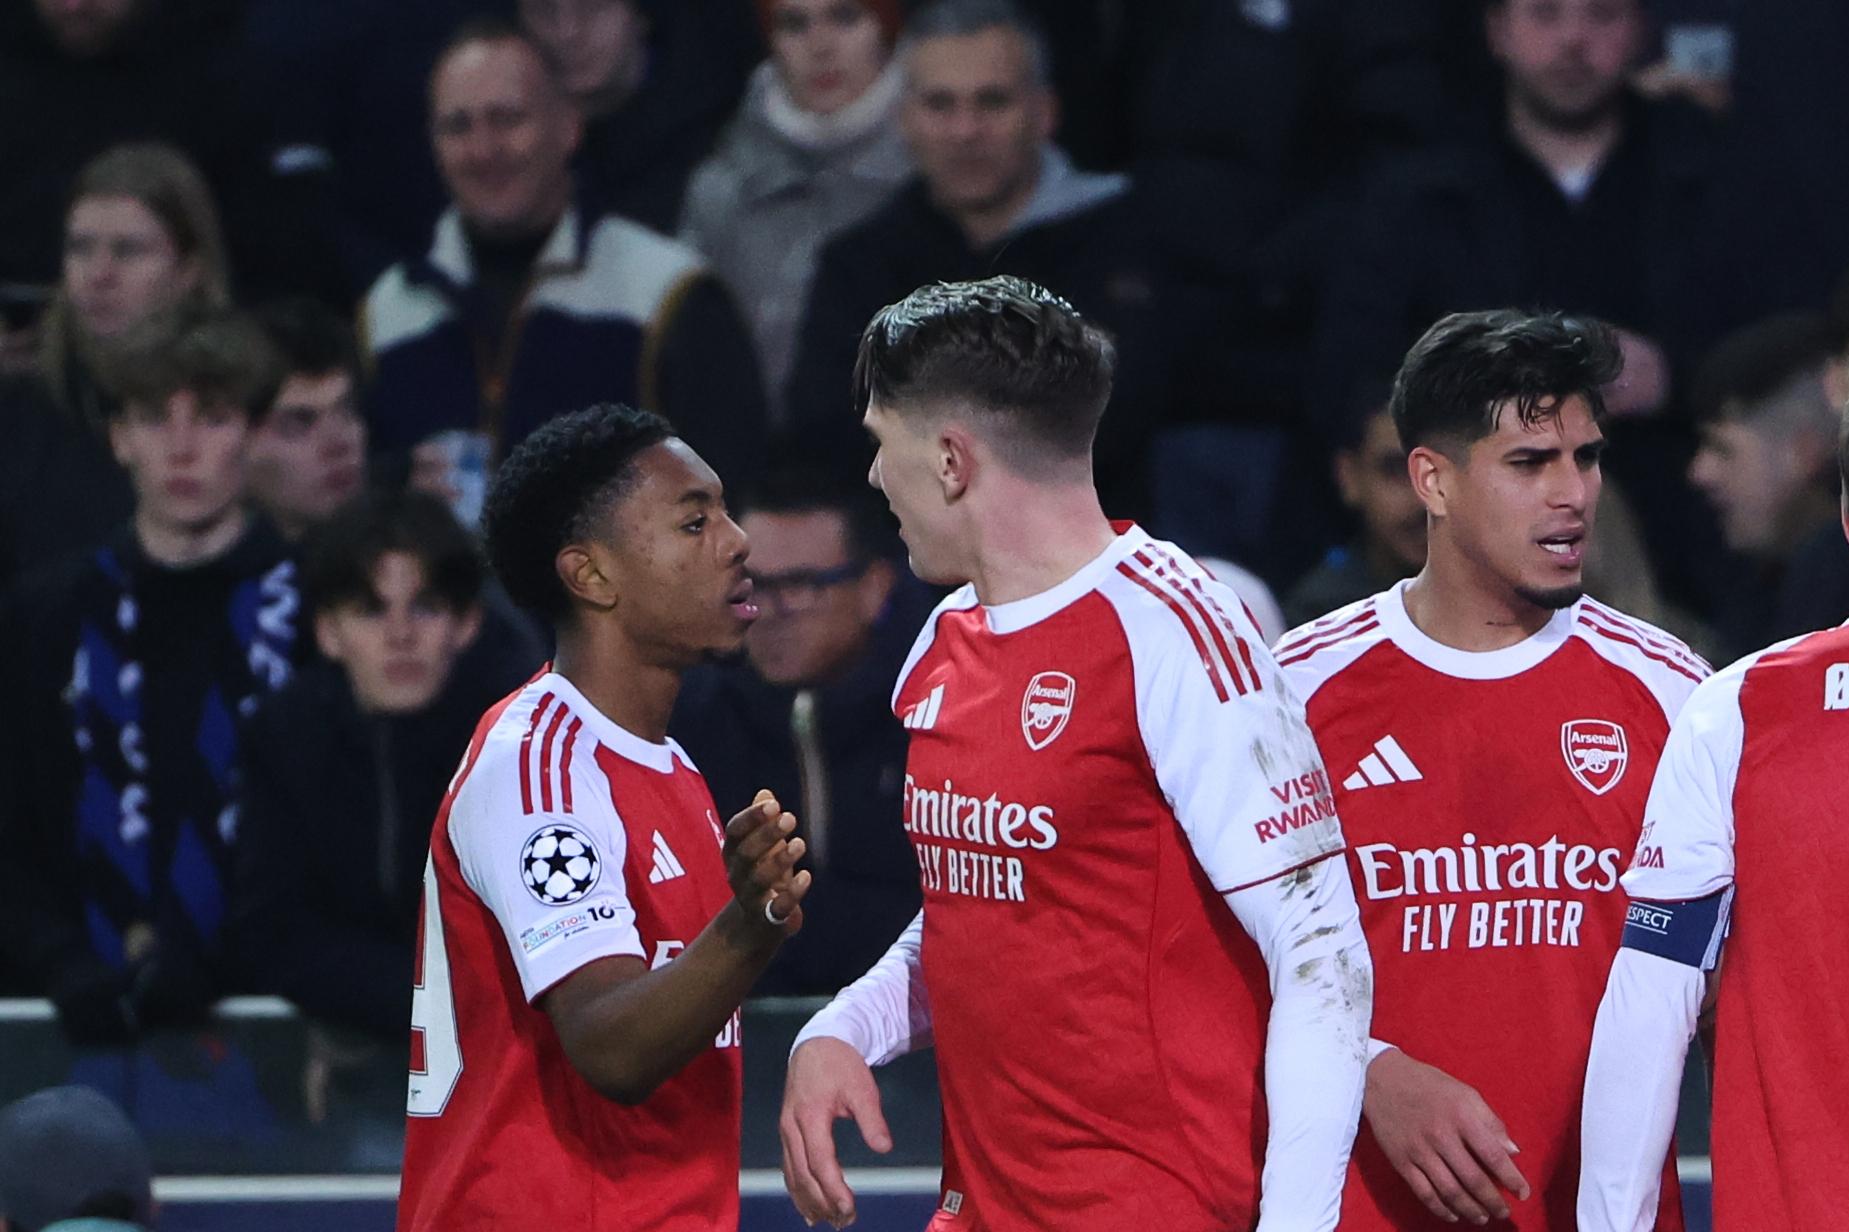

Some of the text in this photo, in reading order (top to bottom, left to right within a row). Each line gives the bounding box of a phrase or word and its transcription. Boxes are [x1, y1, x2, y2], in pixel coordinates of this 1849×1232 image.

[1031, 683, 1069, 701] Arsenal
[1571, 730, 1618, 747] Arsenal
[904, 773, 1058, 850] Emirates
[916, 843, 1026, 903] FLY BETTER
[1354, 832, 1622, 900] Emirates
[1401, 898, 1585, 953] FLY BETTER
[1626, 905, 1673, 929] ESPECT
